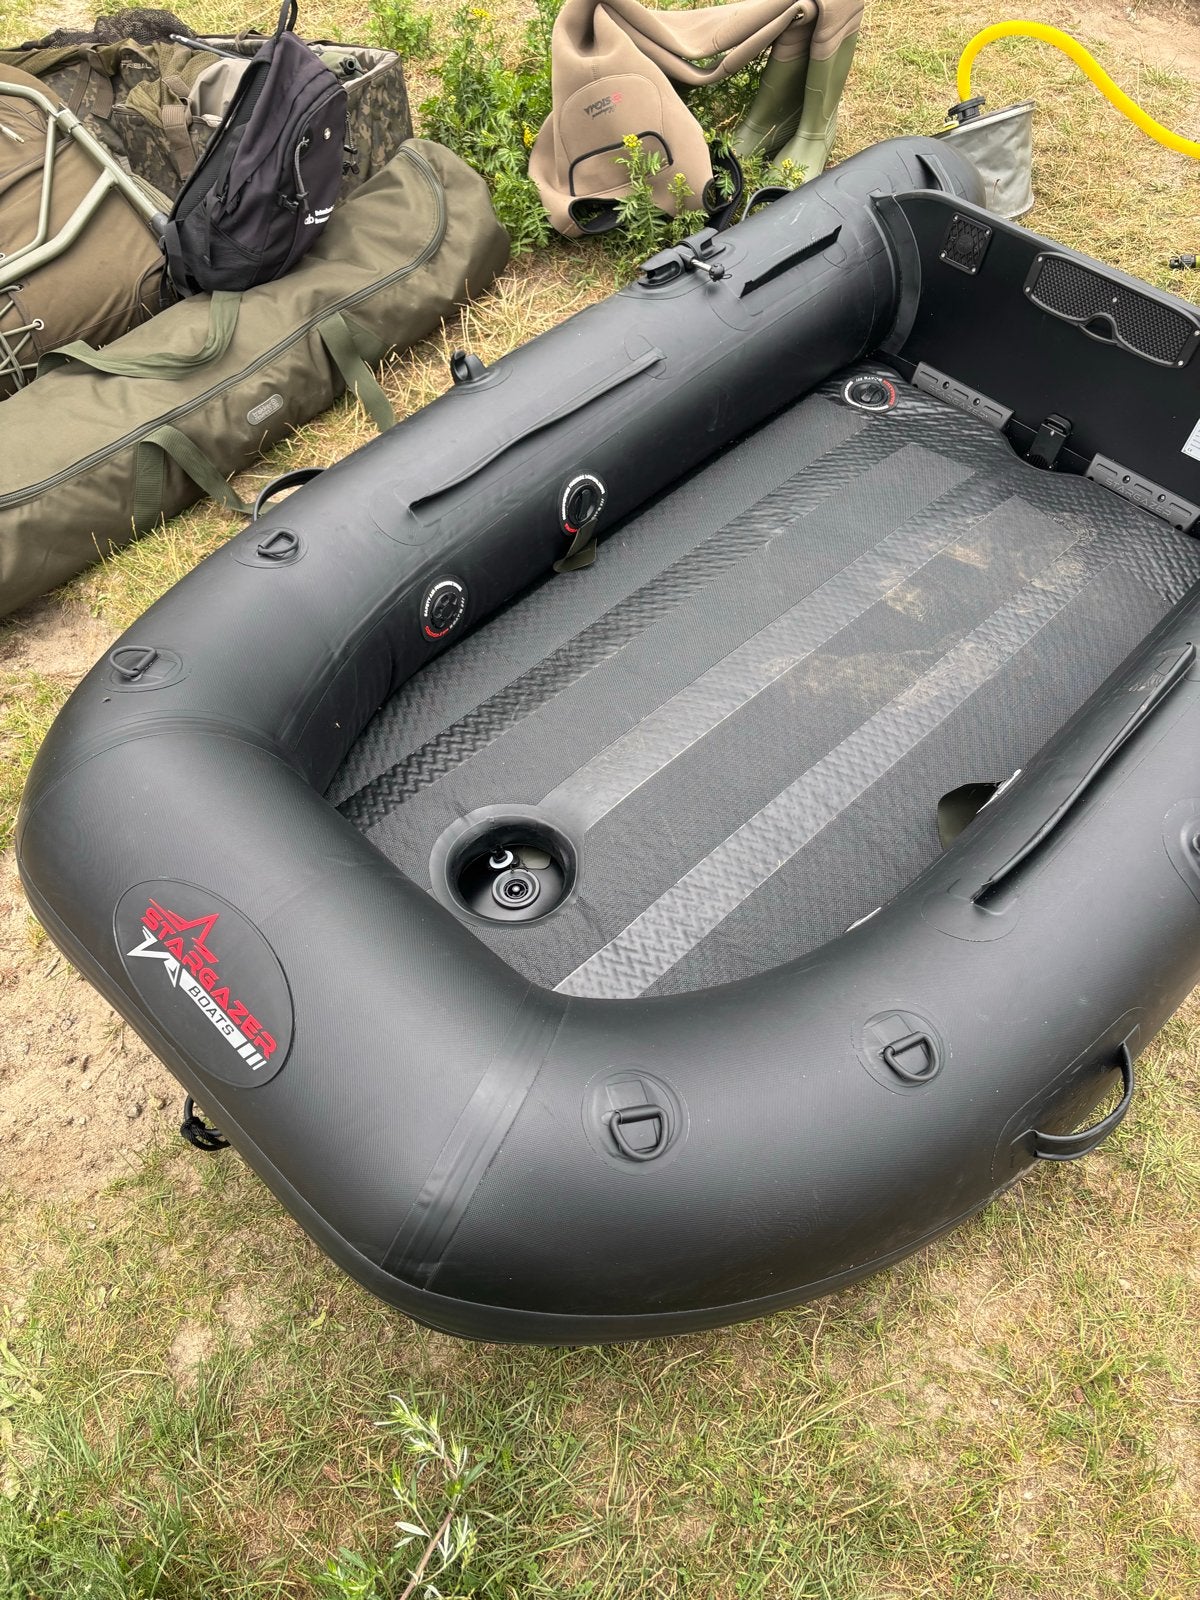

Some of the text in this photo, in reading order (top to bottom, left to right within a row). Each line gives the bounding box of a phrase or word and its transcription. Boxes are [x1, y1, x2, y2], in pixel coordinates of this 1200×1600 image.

[1104, 478, 1172, 517] STARGAZER
[141, 907, 277, 1060] STARGAZER
[187, 985, 235, 1036] BOATS
